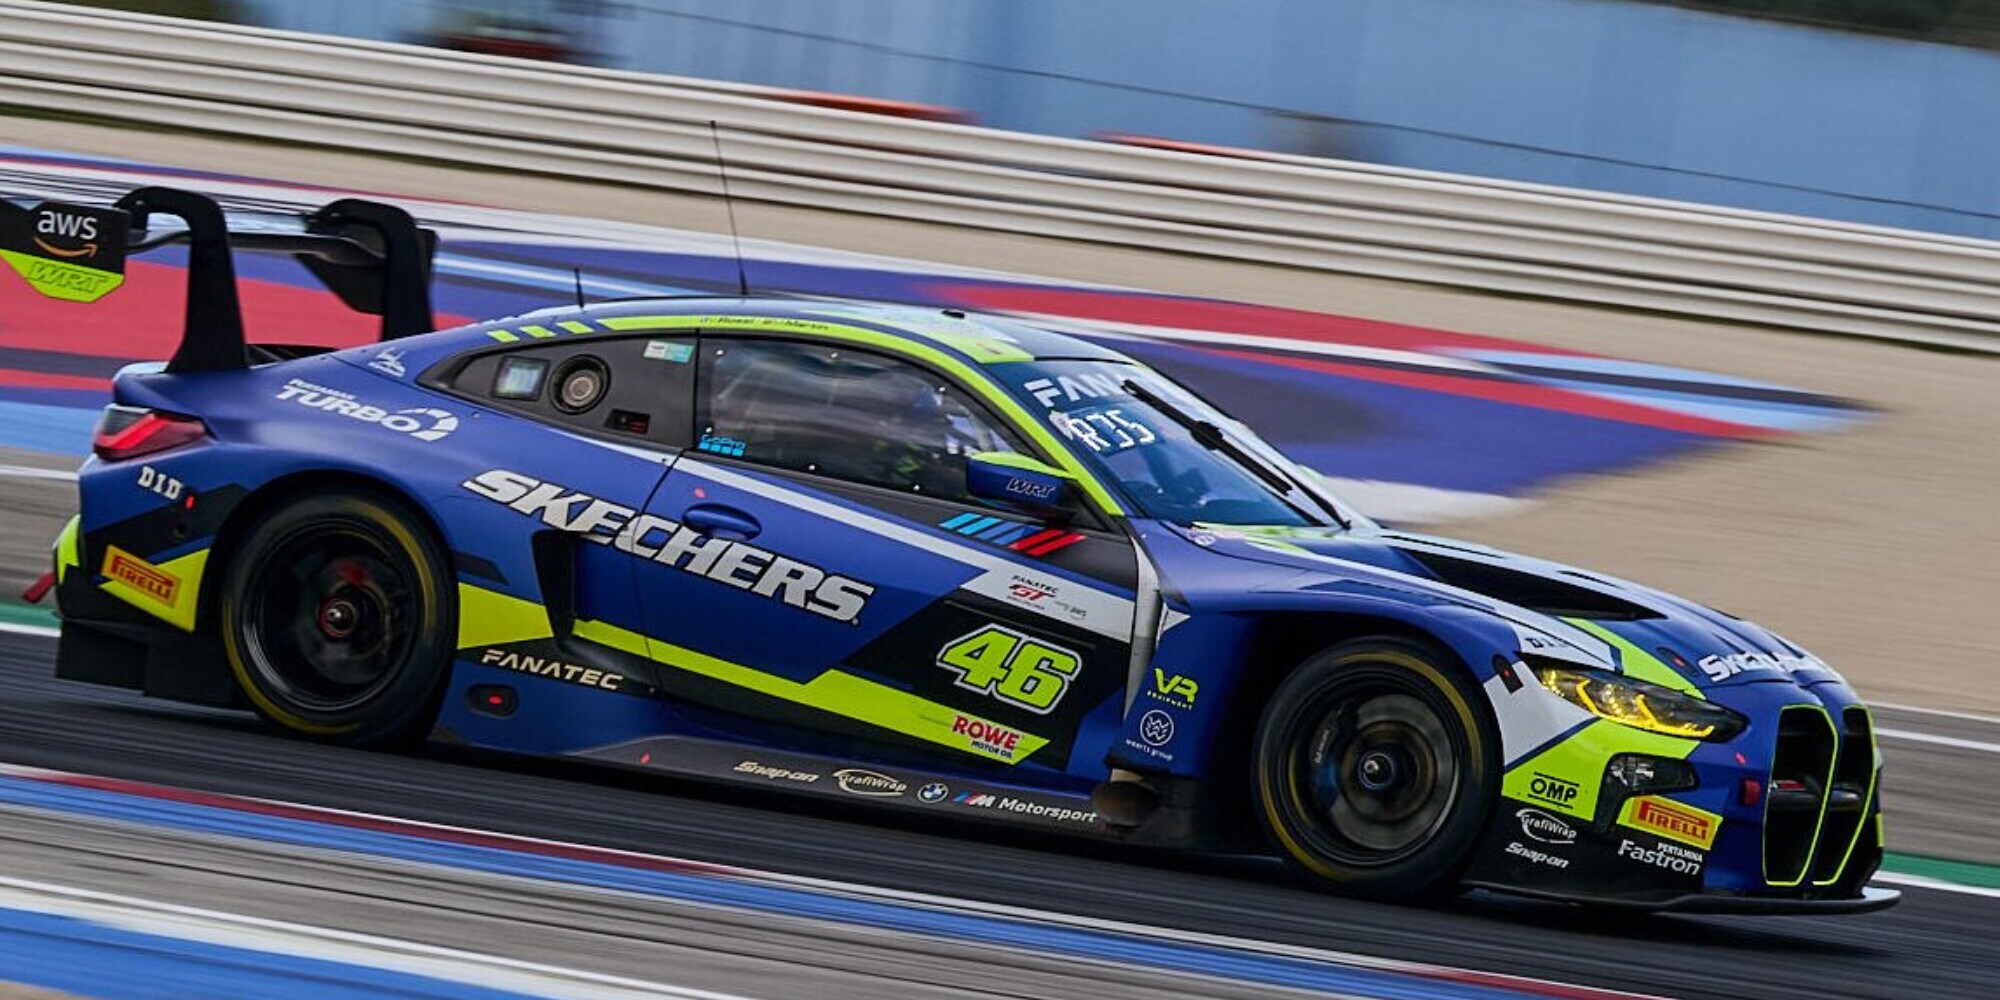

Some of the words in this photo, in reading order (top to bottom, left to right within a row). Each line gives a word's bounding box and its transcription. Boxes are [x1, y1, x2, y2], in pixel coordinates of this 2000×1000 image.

[37, 210, 98, 240] aws
[31, 261, 108, 293] WRT
[276, 385, 421, 432] TURBO
[137, 466, 183, 499] DID
[461, 469, 874, 622] SKECHERS
[110, 554, 175, 600] PIRELLI
[481, 649, 623, 690] FANATEC
[937, 624, 1081, 713] 46
[1154, 667, 1199, 703] VR
[952, 715, 1019, 750] ROWE
[1530, 777, 1578, 803] OMP
[999, 797, 1098, 823] Motorsport
[1638, 800, 1709, 841] PIRELLI
[1617, 838, 1700, 875] Fastron
